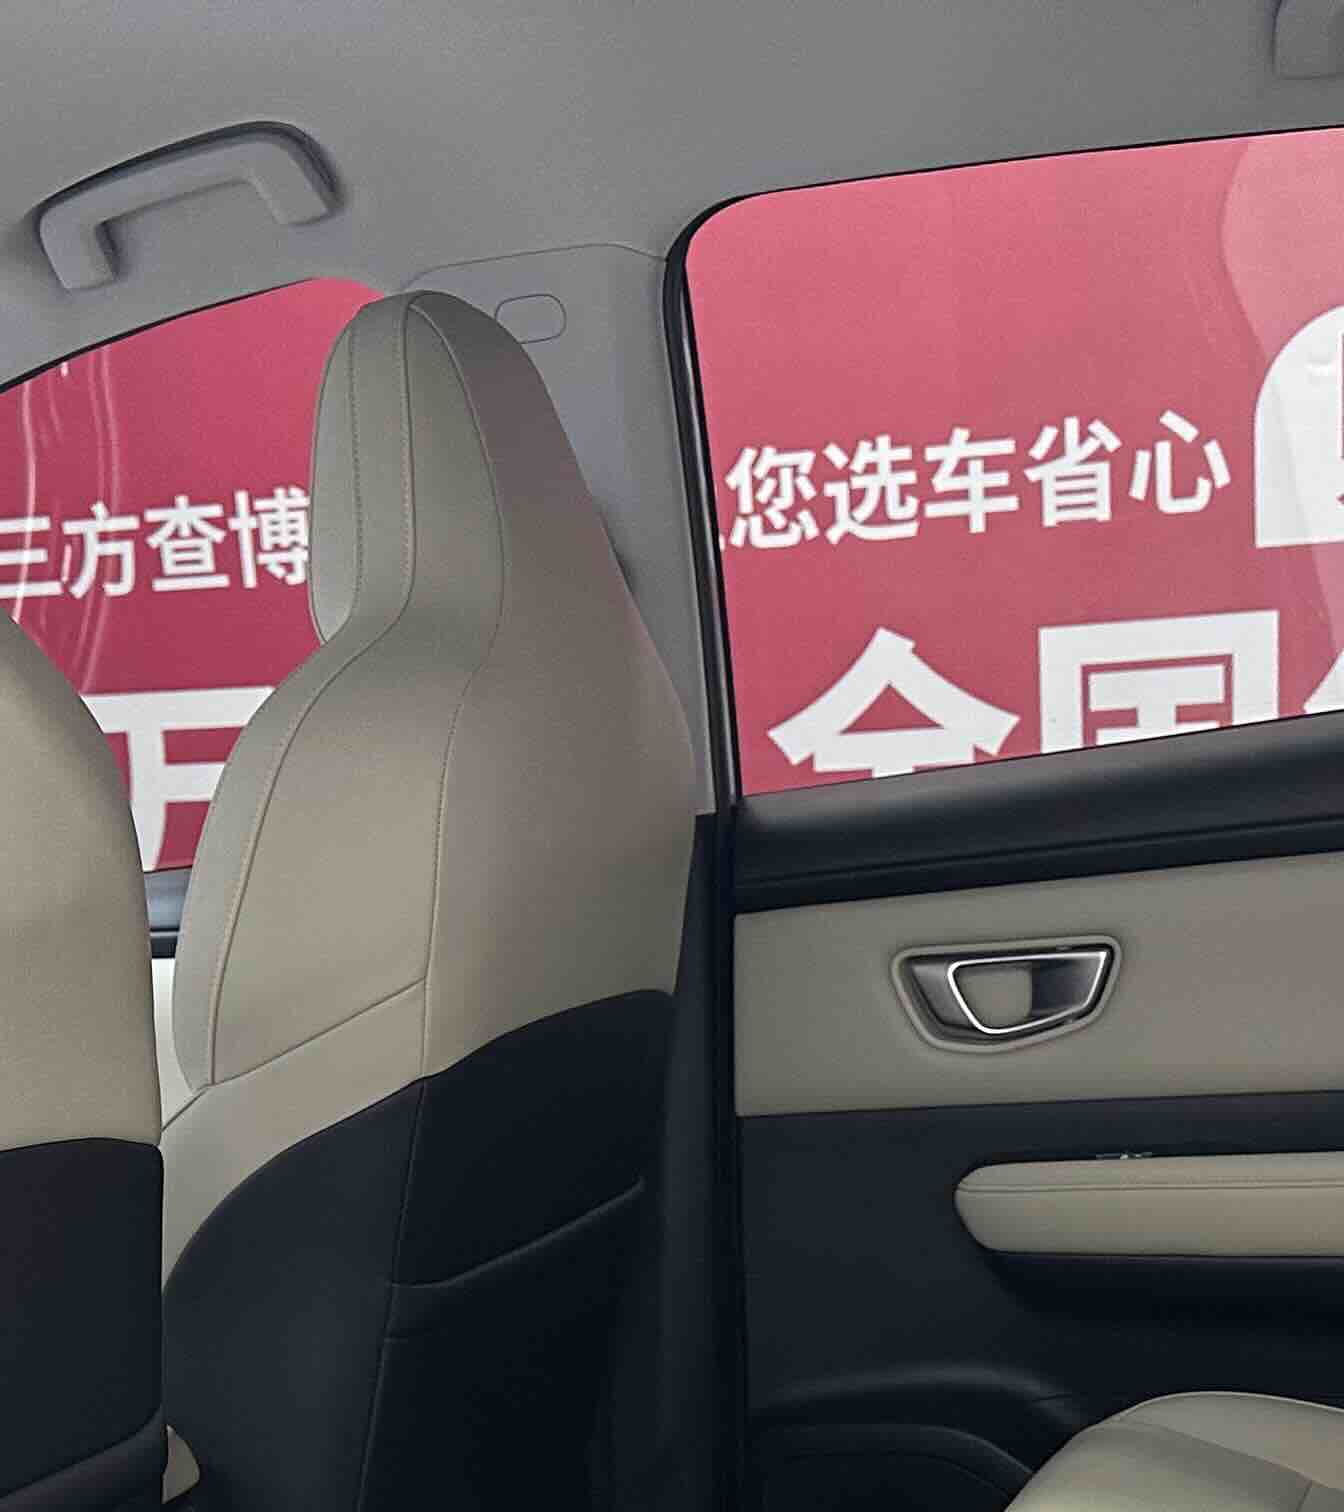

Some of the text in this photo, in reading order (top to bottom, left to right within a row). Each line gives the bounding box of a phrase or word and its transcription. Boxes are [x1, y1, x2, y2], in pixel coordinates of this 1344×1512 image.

[725, 410, 1232, 549] 您选车省心
